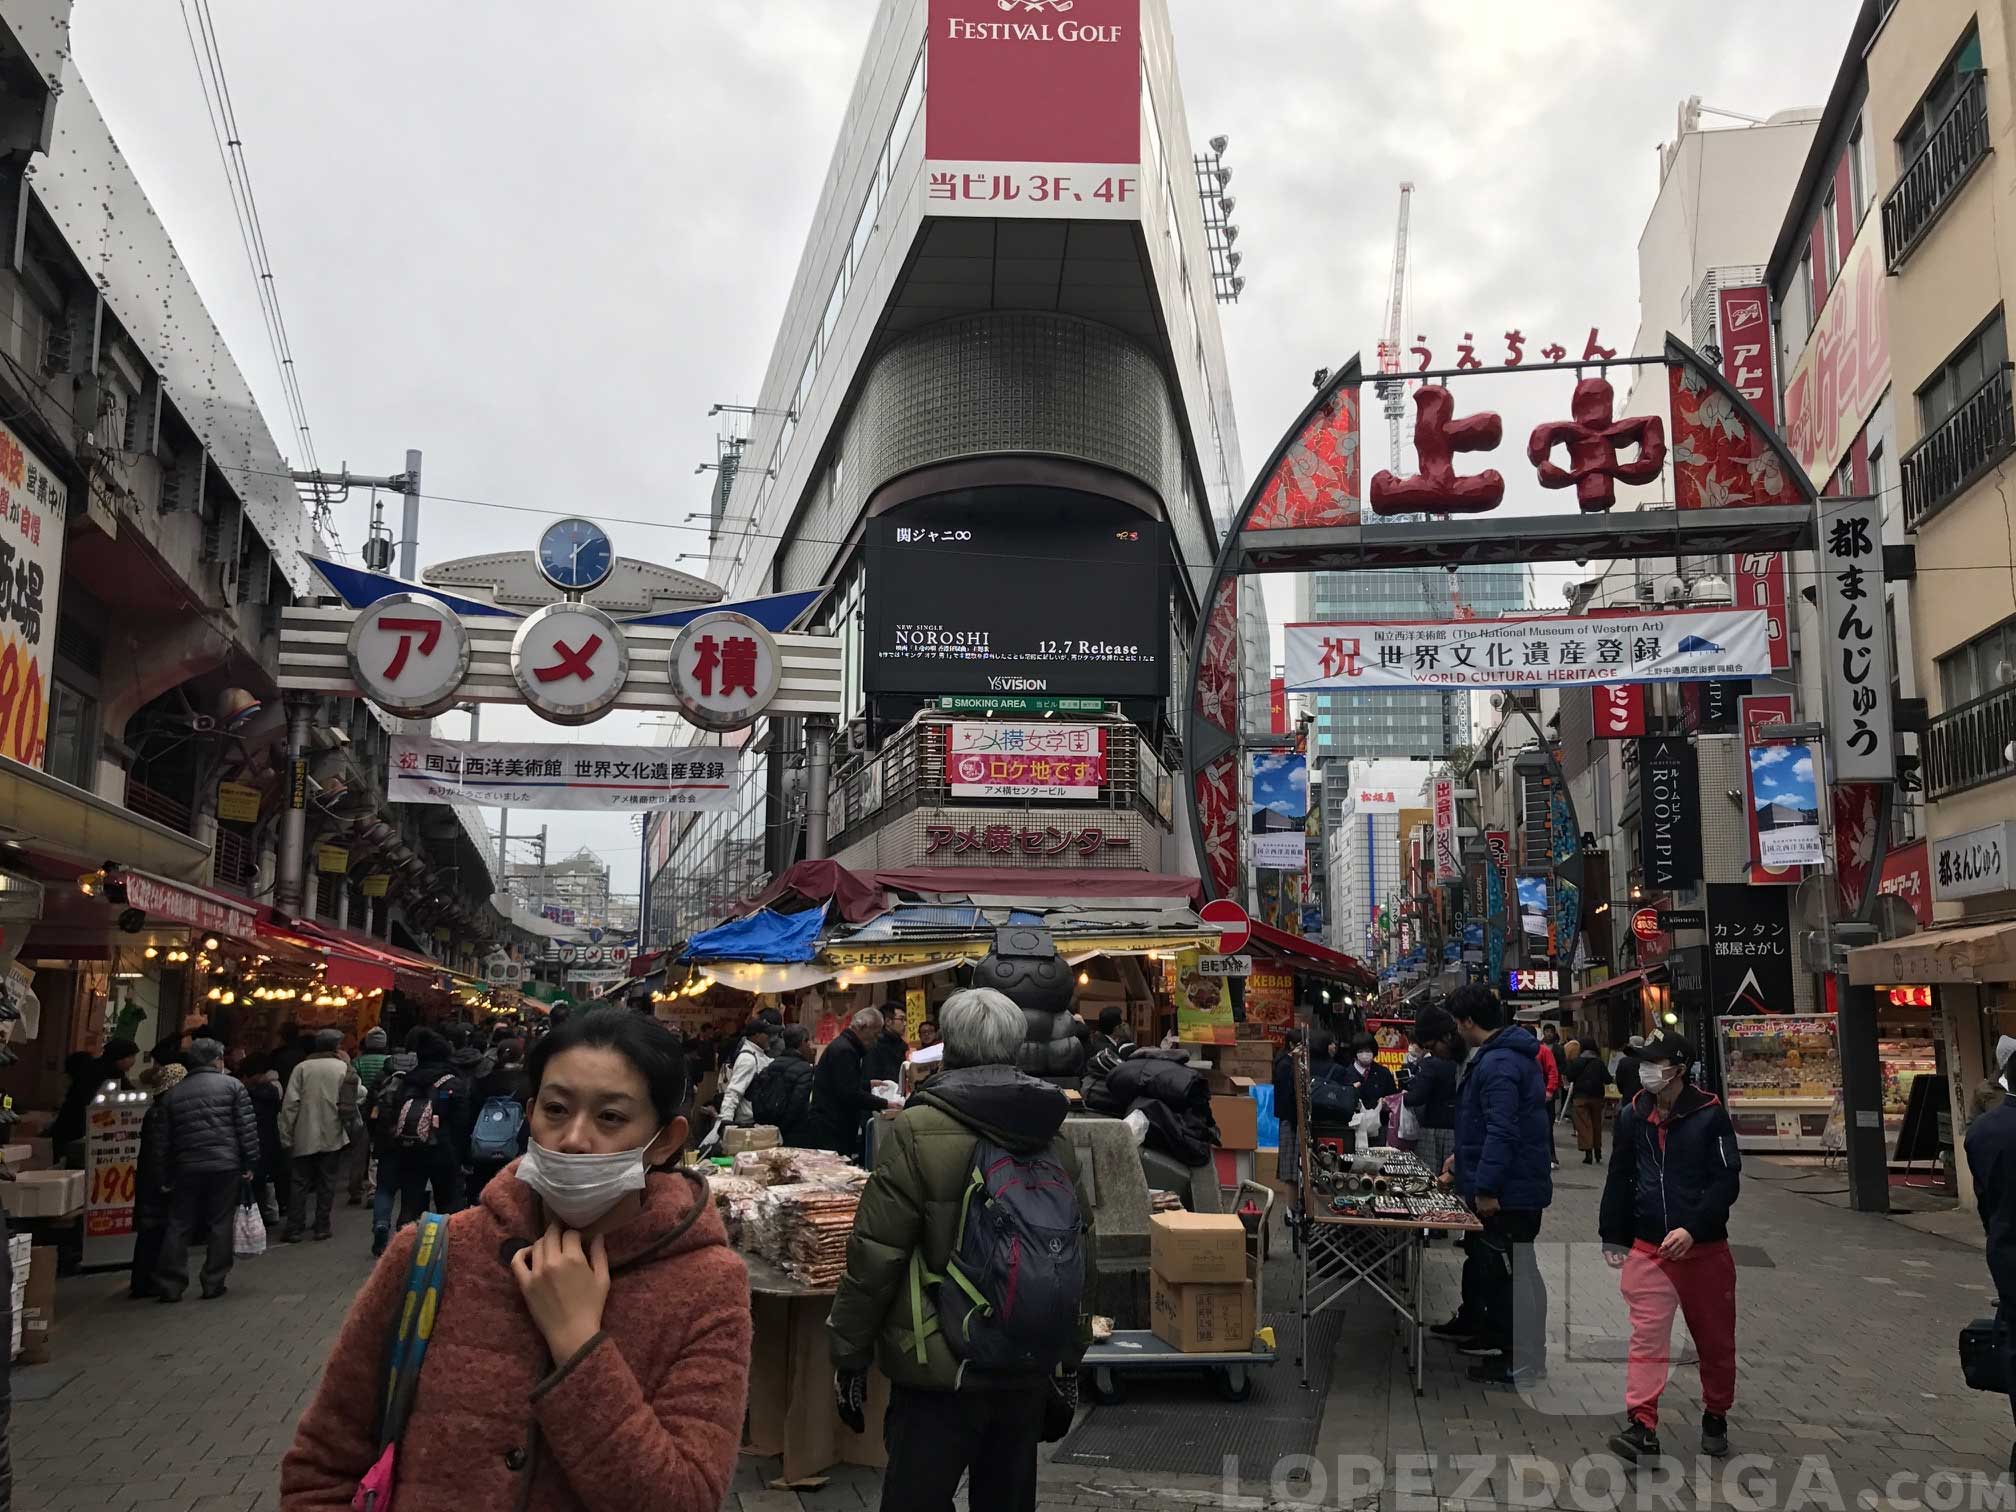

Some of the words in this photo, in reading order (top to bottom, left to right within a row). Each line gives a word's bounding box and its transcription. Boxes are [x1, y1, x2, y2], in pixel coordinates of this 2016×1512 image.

[948, 18, 1053, 41] FESTIVAL
[1058, 21, 1121, 42] GOLF
[929, 173, 1020, 201] 当ビル
[1370, 378, 1666, 515] 上中
[895, 631, 990, 646] NOROSHI
[1374, 630, 1448, 641] 国立西洋美術館
[1480, 628, 1526, 639] National
[1530, 627, 1575, 637] Museum
[1578, 626, 1589, 636] of
[1592, 623, 1640, 635] Western
[1827, 517, 1880, 757] 都まんじゅう
[377, 617, 758, 698] アメ横
[1039, 641, 1072, 654] 12.7
[1078, 641, 1139, 655] Release
[1317, 637, 1361, 679] 祝
[1377, 638, 1662, 671] 世界文化遺産登録
[1002, 679, 1047, 691] VISION
[1414, 672, 1467, 683] WORLD
[1471, 671, 1542, 682] CULTURAL
[1547, 668, 1619, 680] HERITAGE
[955, 699, 998, 708] SMOKING
[1001, 700, 1026, 709] AREA
[961, 727, 1090, 752] アメ横女学園
[400, 751, 419, 771] 祝
[425, 754, 563, 779] 国立西洋美術館
[575, 760, 725, 780] 世界文化遺産登録
[991, 761, 1090, 779] ロケ地です
[985, 786, 1066, 797] アメ横センタービル
[1653, 768, 1673, 884] ROOMPIA
[926, 825, 1130, 857] アメ横センター
[1938, 841, 2001, 889] 都まんじゅう
[1714, 922, 1784, 937] カンタン
[1714, 941, 1785, 956] 部屋さがし
[1254, 975, 1292, 987] KEBAB
